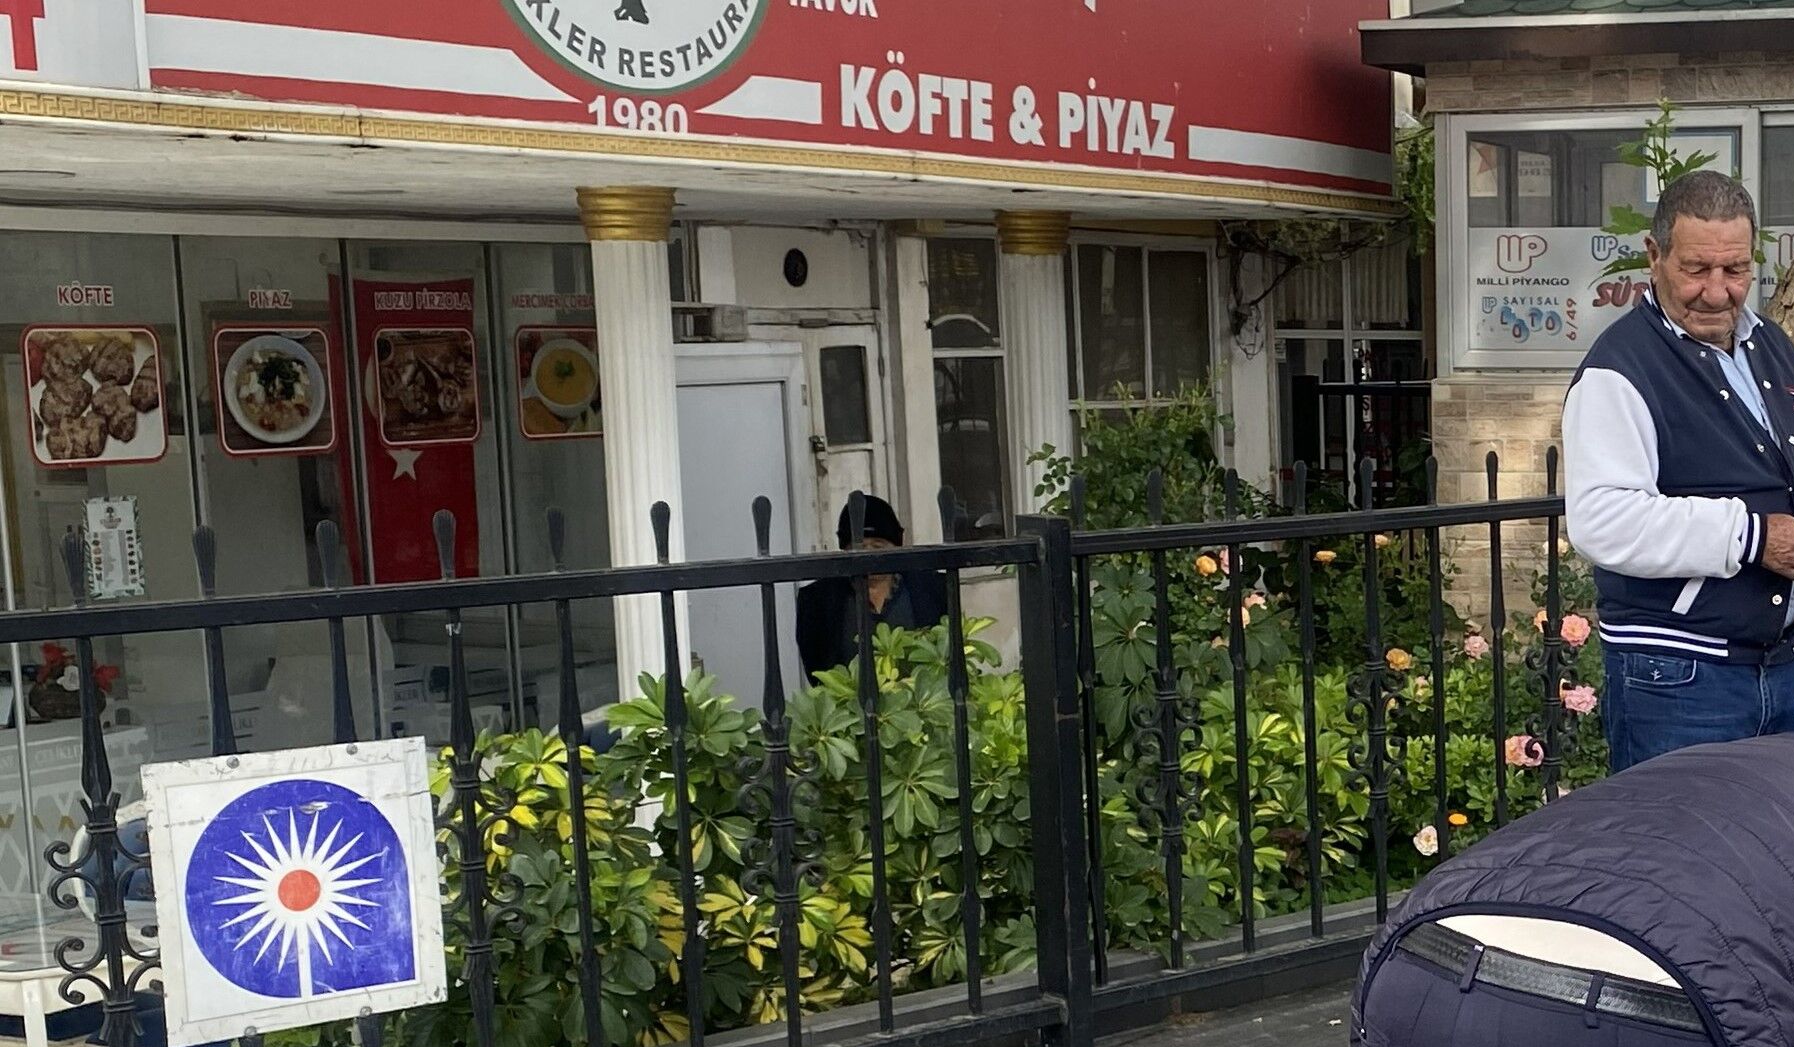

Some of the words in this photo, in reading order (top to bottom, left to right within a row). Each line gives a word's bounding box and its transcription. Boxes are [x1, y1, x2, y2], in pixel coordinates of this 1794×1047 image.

[526, 0, 608, 69] KLER
[588, 95, 689, 134] 1980
[840, 50, 993, 142] KÖFTE
[1009, 85, 1046, 147] &
[1058, 77, 1175, 159] PİYAZ
[1512, 276, 1570, 286] PİYANGO
[57, 282, 114, 306] KÖFTE
[375, 292, 413, 310] KUZU
[416, 288, 472, 310] PİRZOLA
[1503, 297, 1560, 306] SAYISAL
